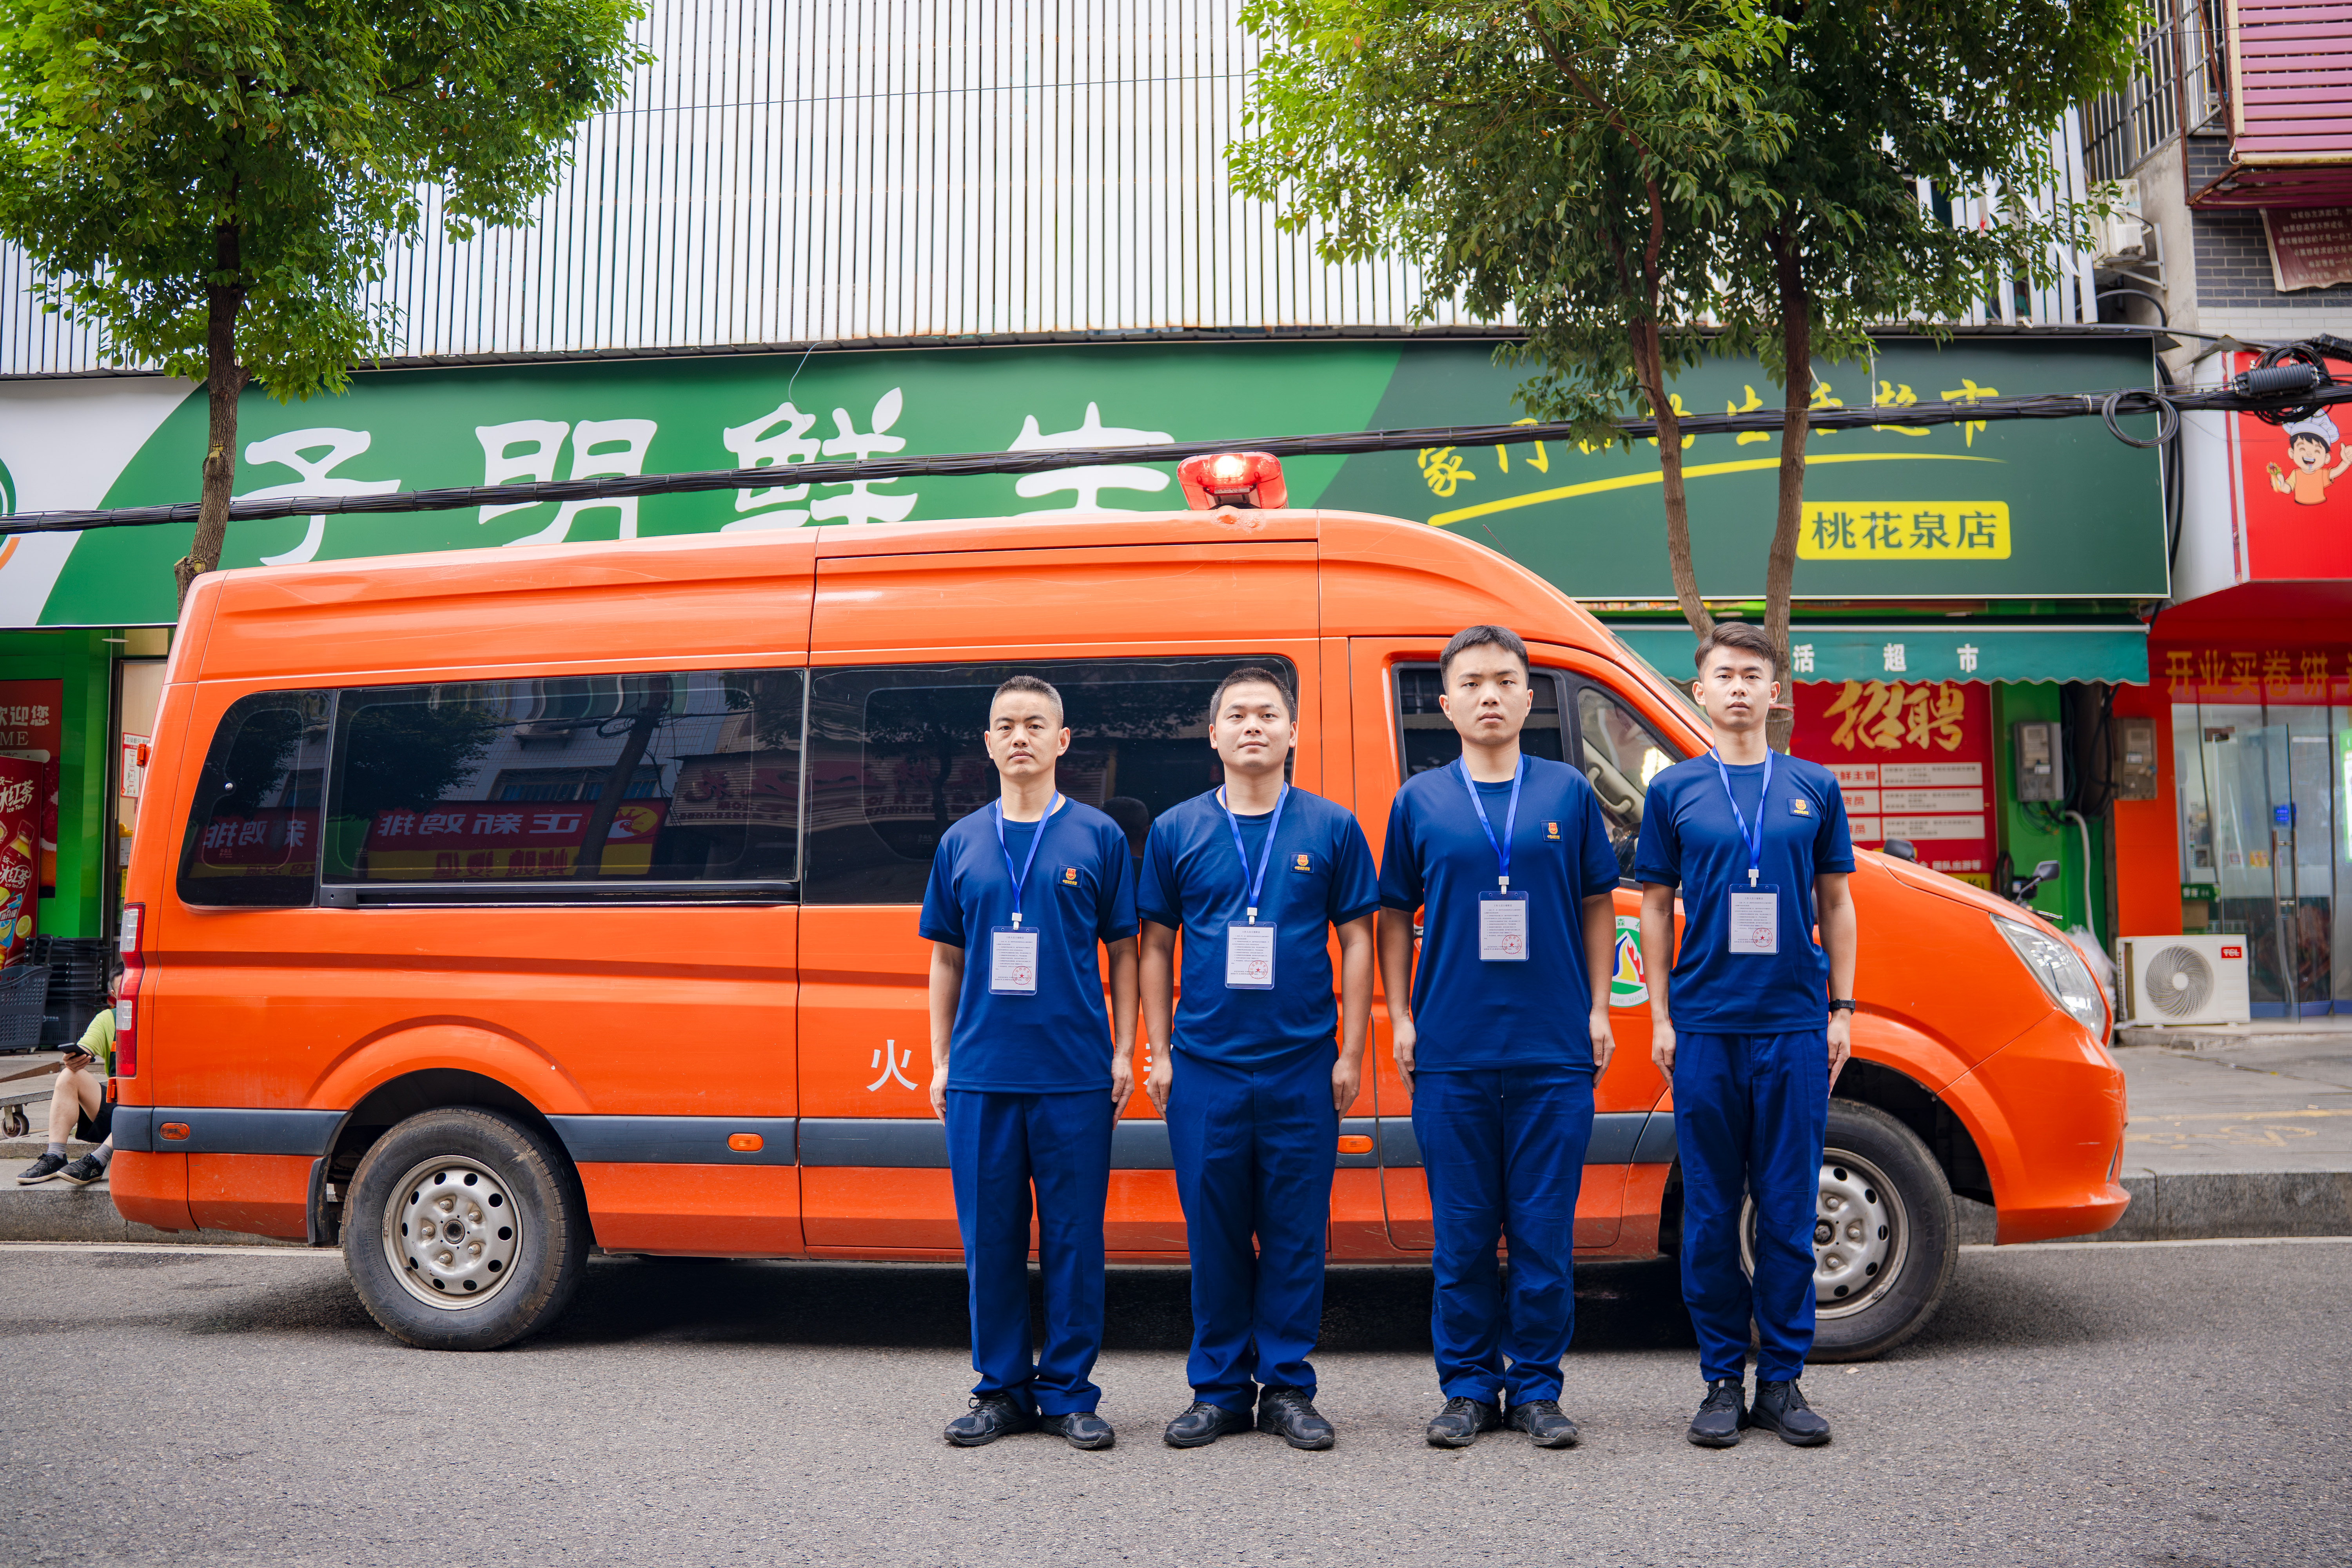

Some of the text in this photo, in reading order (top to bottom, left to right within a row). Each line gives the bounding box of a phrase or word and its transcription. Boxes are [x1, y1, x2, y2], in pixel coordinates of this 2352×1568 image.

[231, 387, 1175, 566] 子明鲜生
[1811, 511, 1997, 550] 桃花泉店
[2165, 649, 2352, 697] 开业买卷饼，
[1823, 680, 1965, 752] 招聘
[2223, 948, 2240, 957] TCL
[866, 1040, 918, 1092] 火
[384, 1312, 474, 1342] LINGLONG
